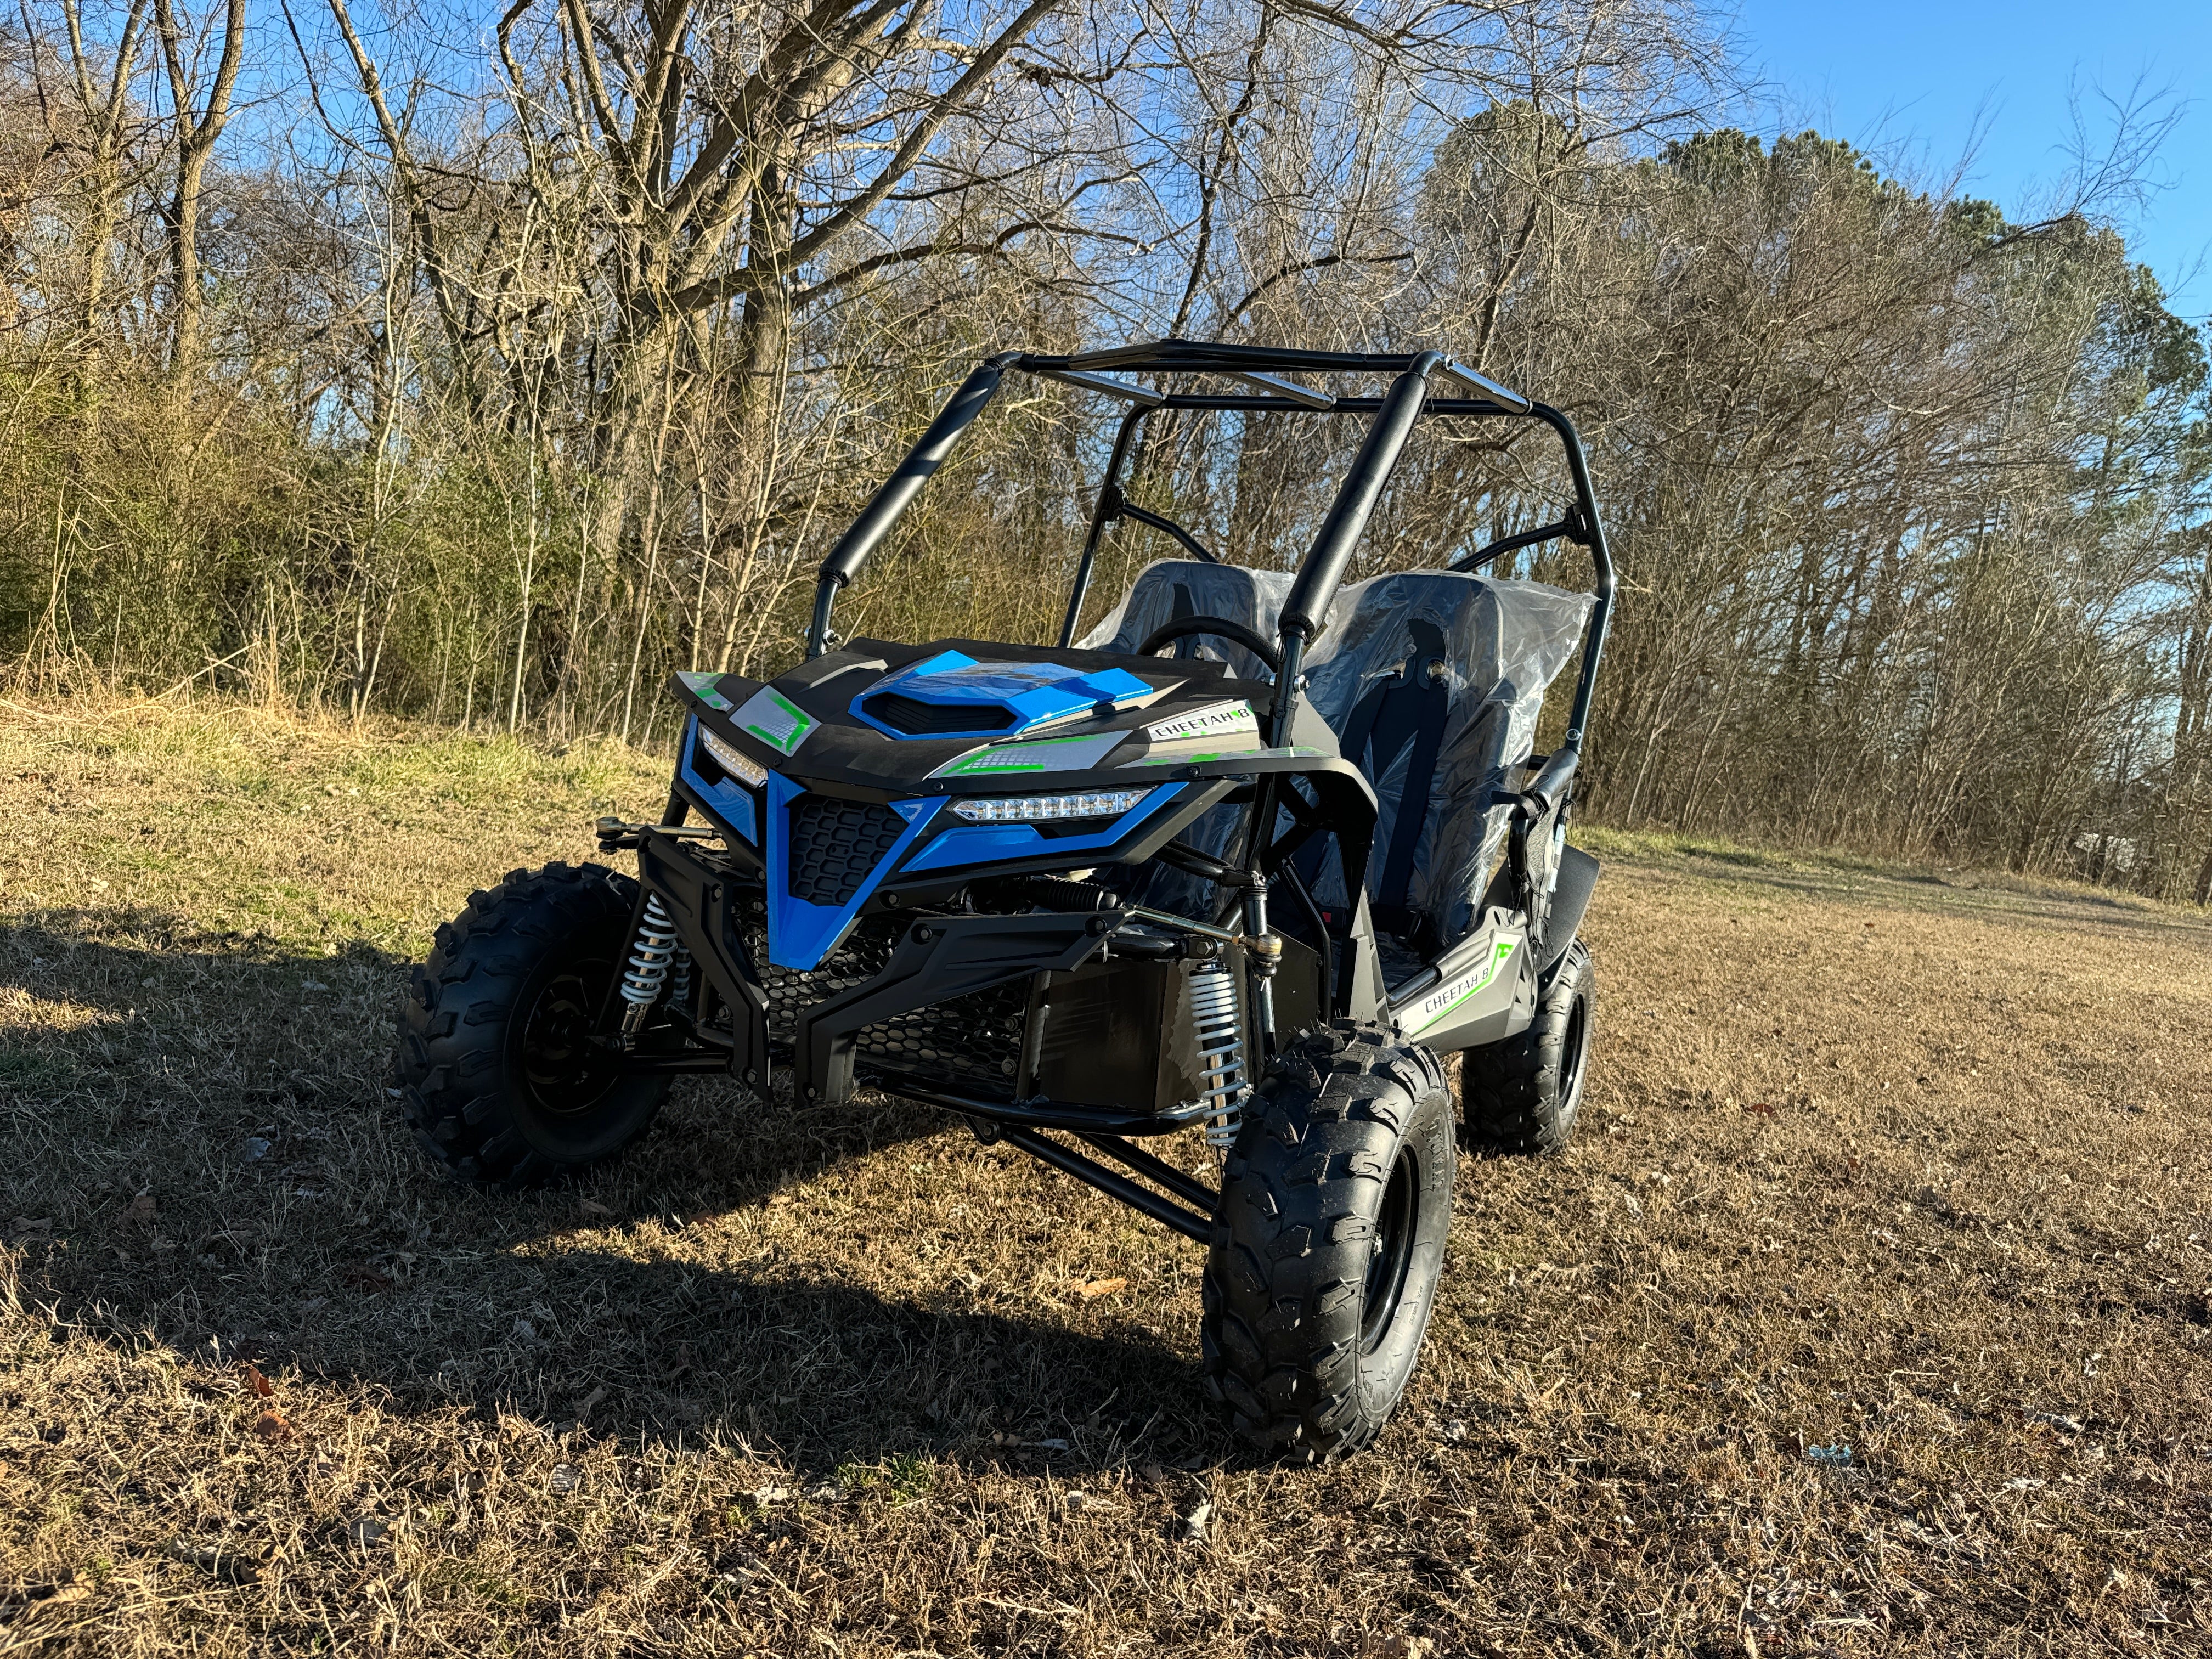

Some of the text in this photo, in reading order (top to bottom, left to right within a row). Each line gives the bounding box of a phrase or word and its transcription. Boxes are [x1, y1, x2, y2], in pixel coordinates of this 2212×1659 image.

[1155, 708, 1250, 737] CHEETAH 8
[1425, 967, 1489, 1013] CHEETAH 8
